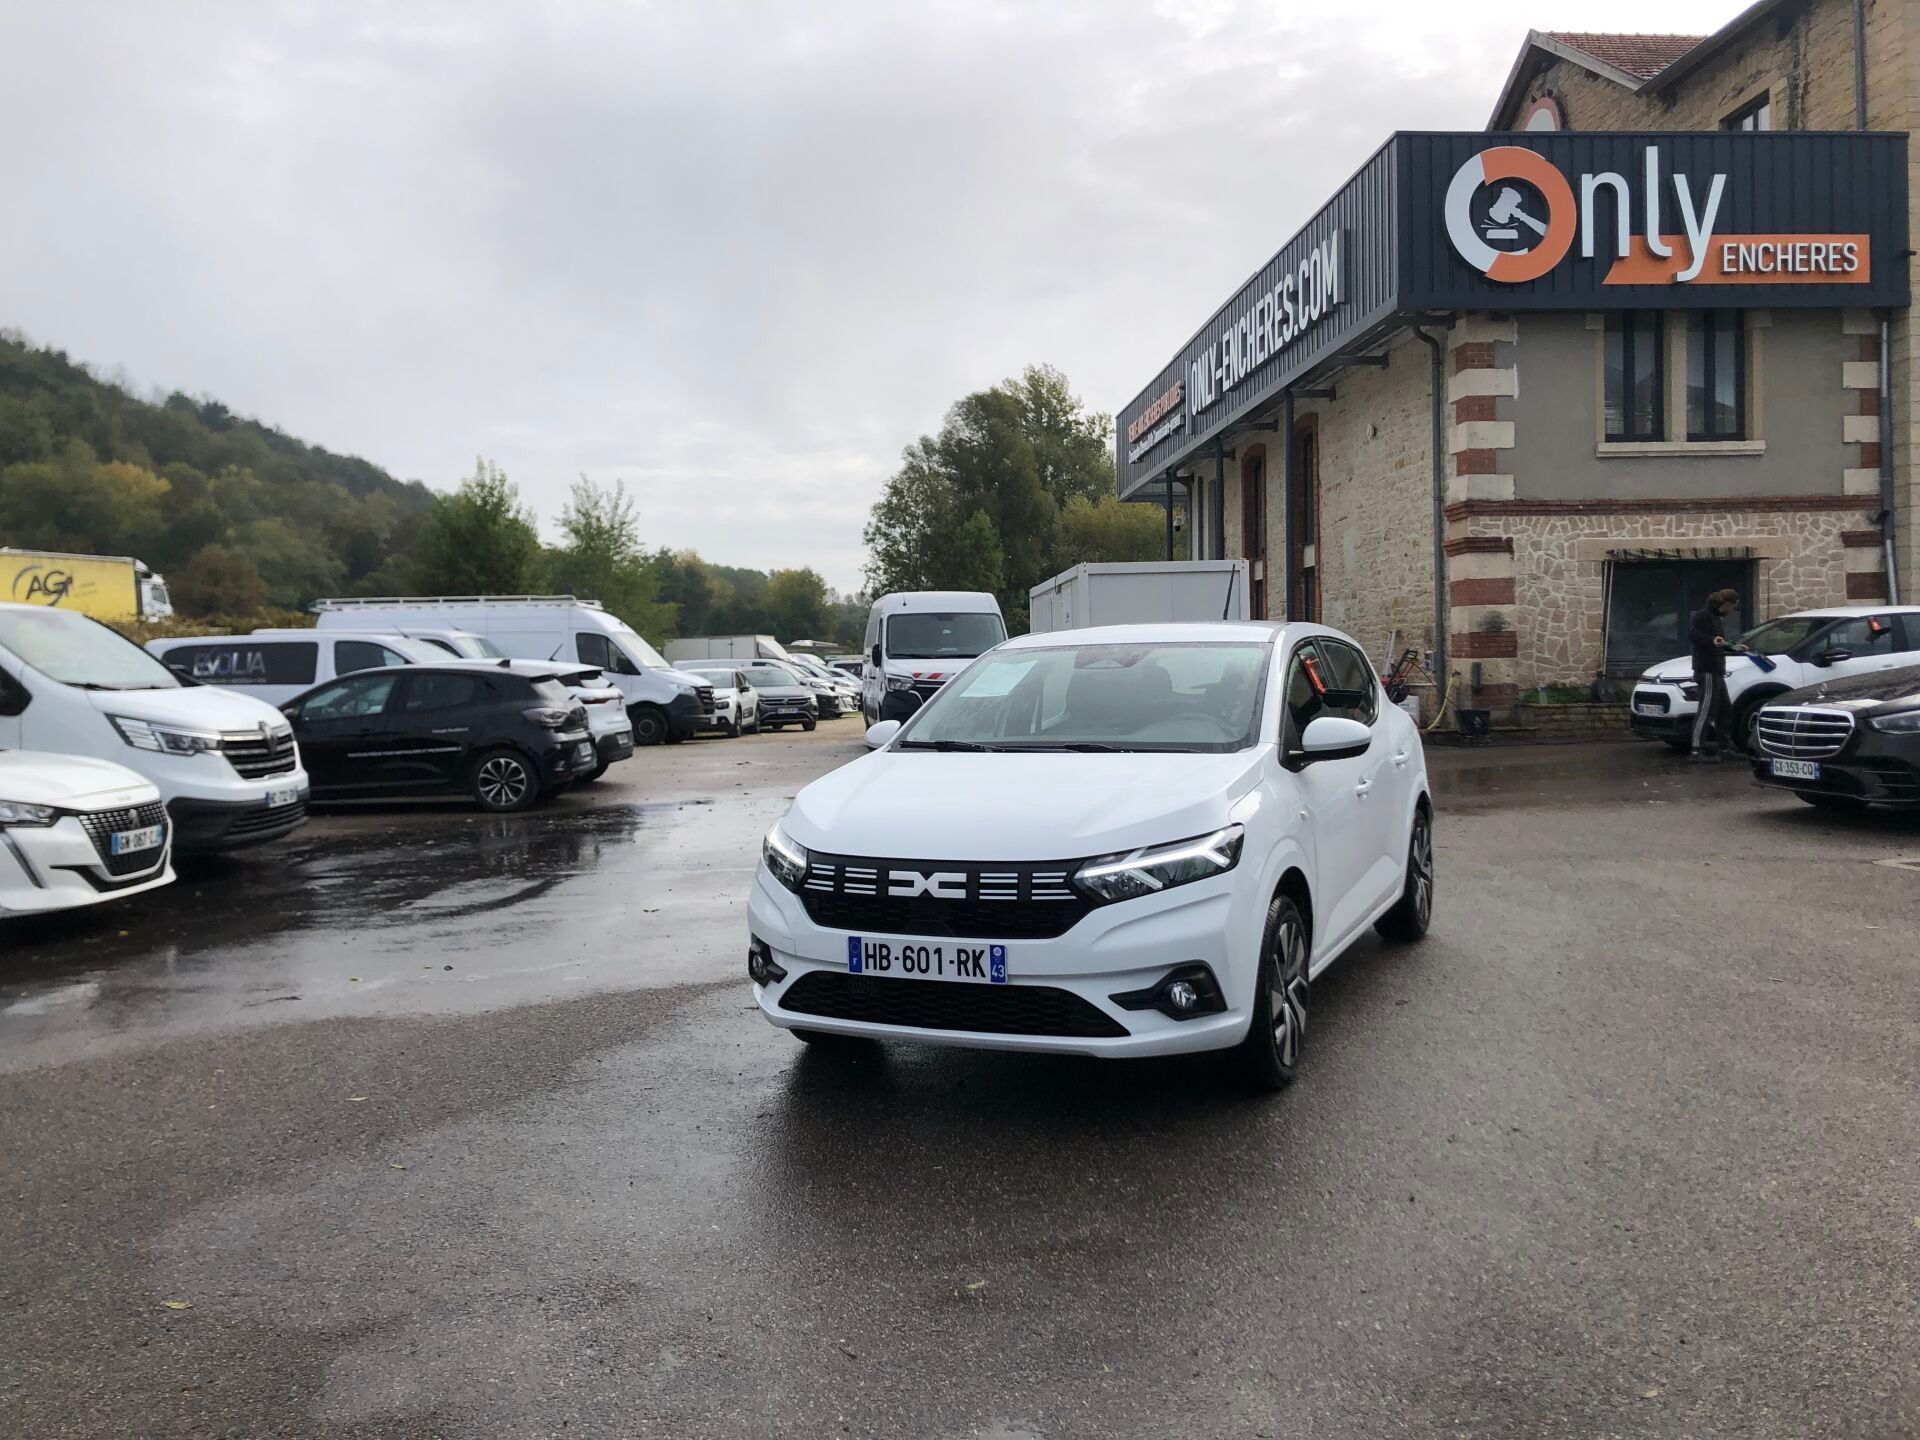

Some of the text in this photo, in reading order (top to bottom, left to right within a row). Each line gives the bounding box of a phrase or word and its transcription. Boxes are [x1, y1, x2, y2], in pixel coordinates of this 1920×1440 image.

[1445, 145, 1727, 283] Only
[1722, 243, 1858, 273] ENCHERES
[1191, 229, 1338, 416] ONLY-ENCHERES.COM
[864, 942, 986, 978] HB-601-RK
[991, 964, 1005, 978] 43
